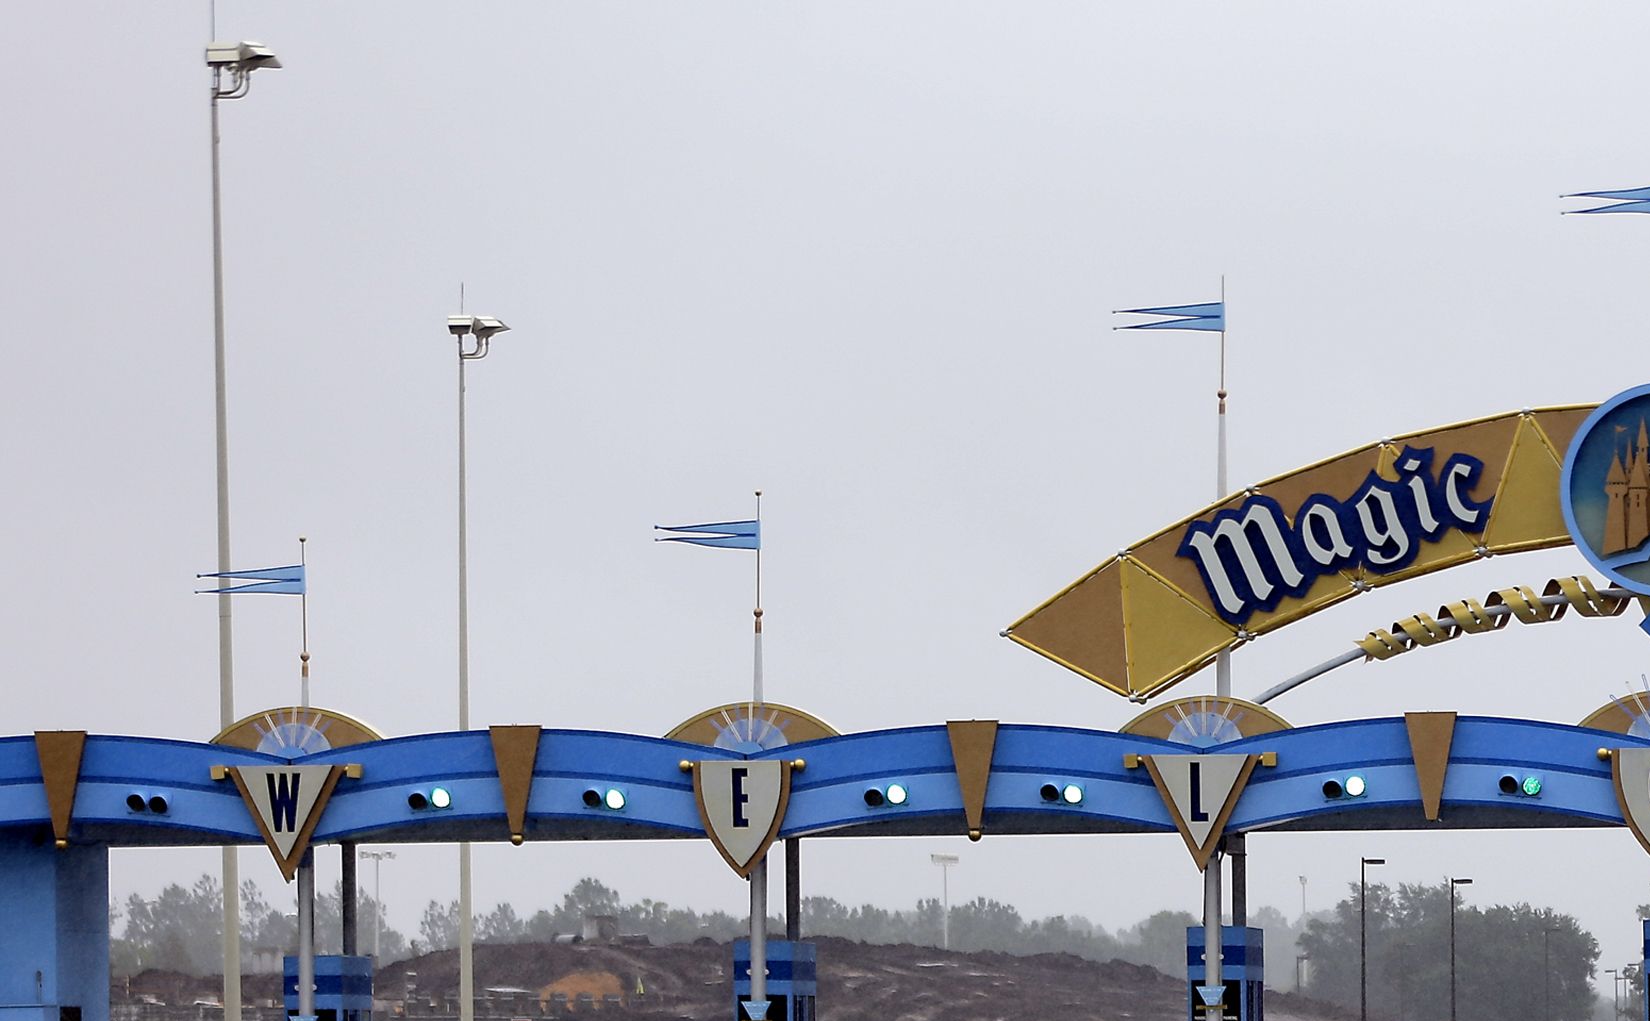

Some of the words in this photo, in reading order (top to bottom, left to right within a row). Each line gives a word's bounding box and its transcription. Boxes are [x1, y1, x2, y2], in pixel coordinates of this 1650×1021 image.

[1184, 453, 1486, 618] Magic
[265, 772, 301, 833] W
[731, 767, 749, 828] E
[1189, 761, 1209, 823] L
